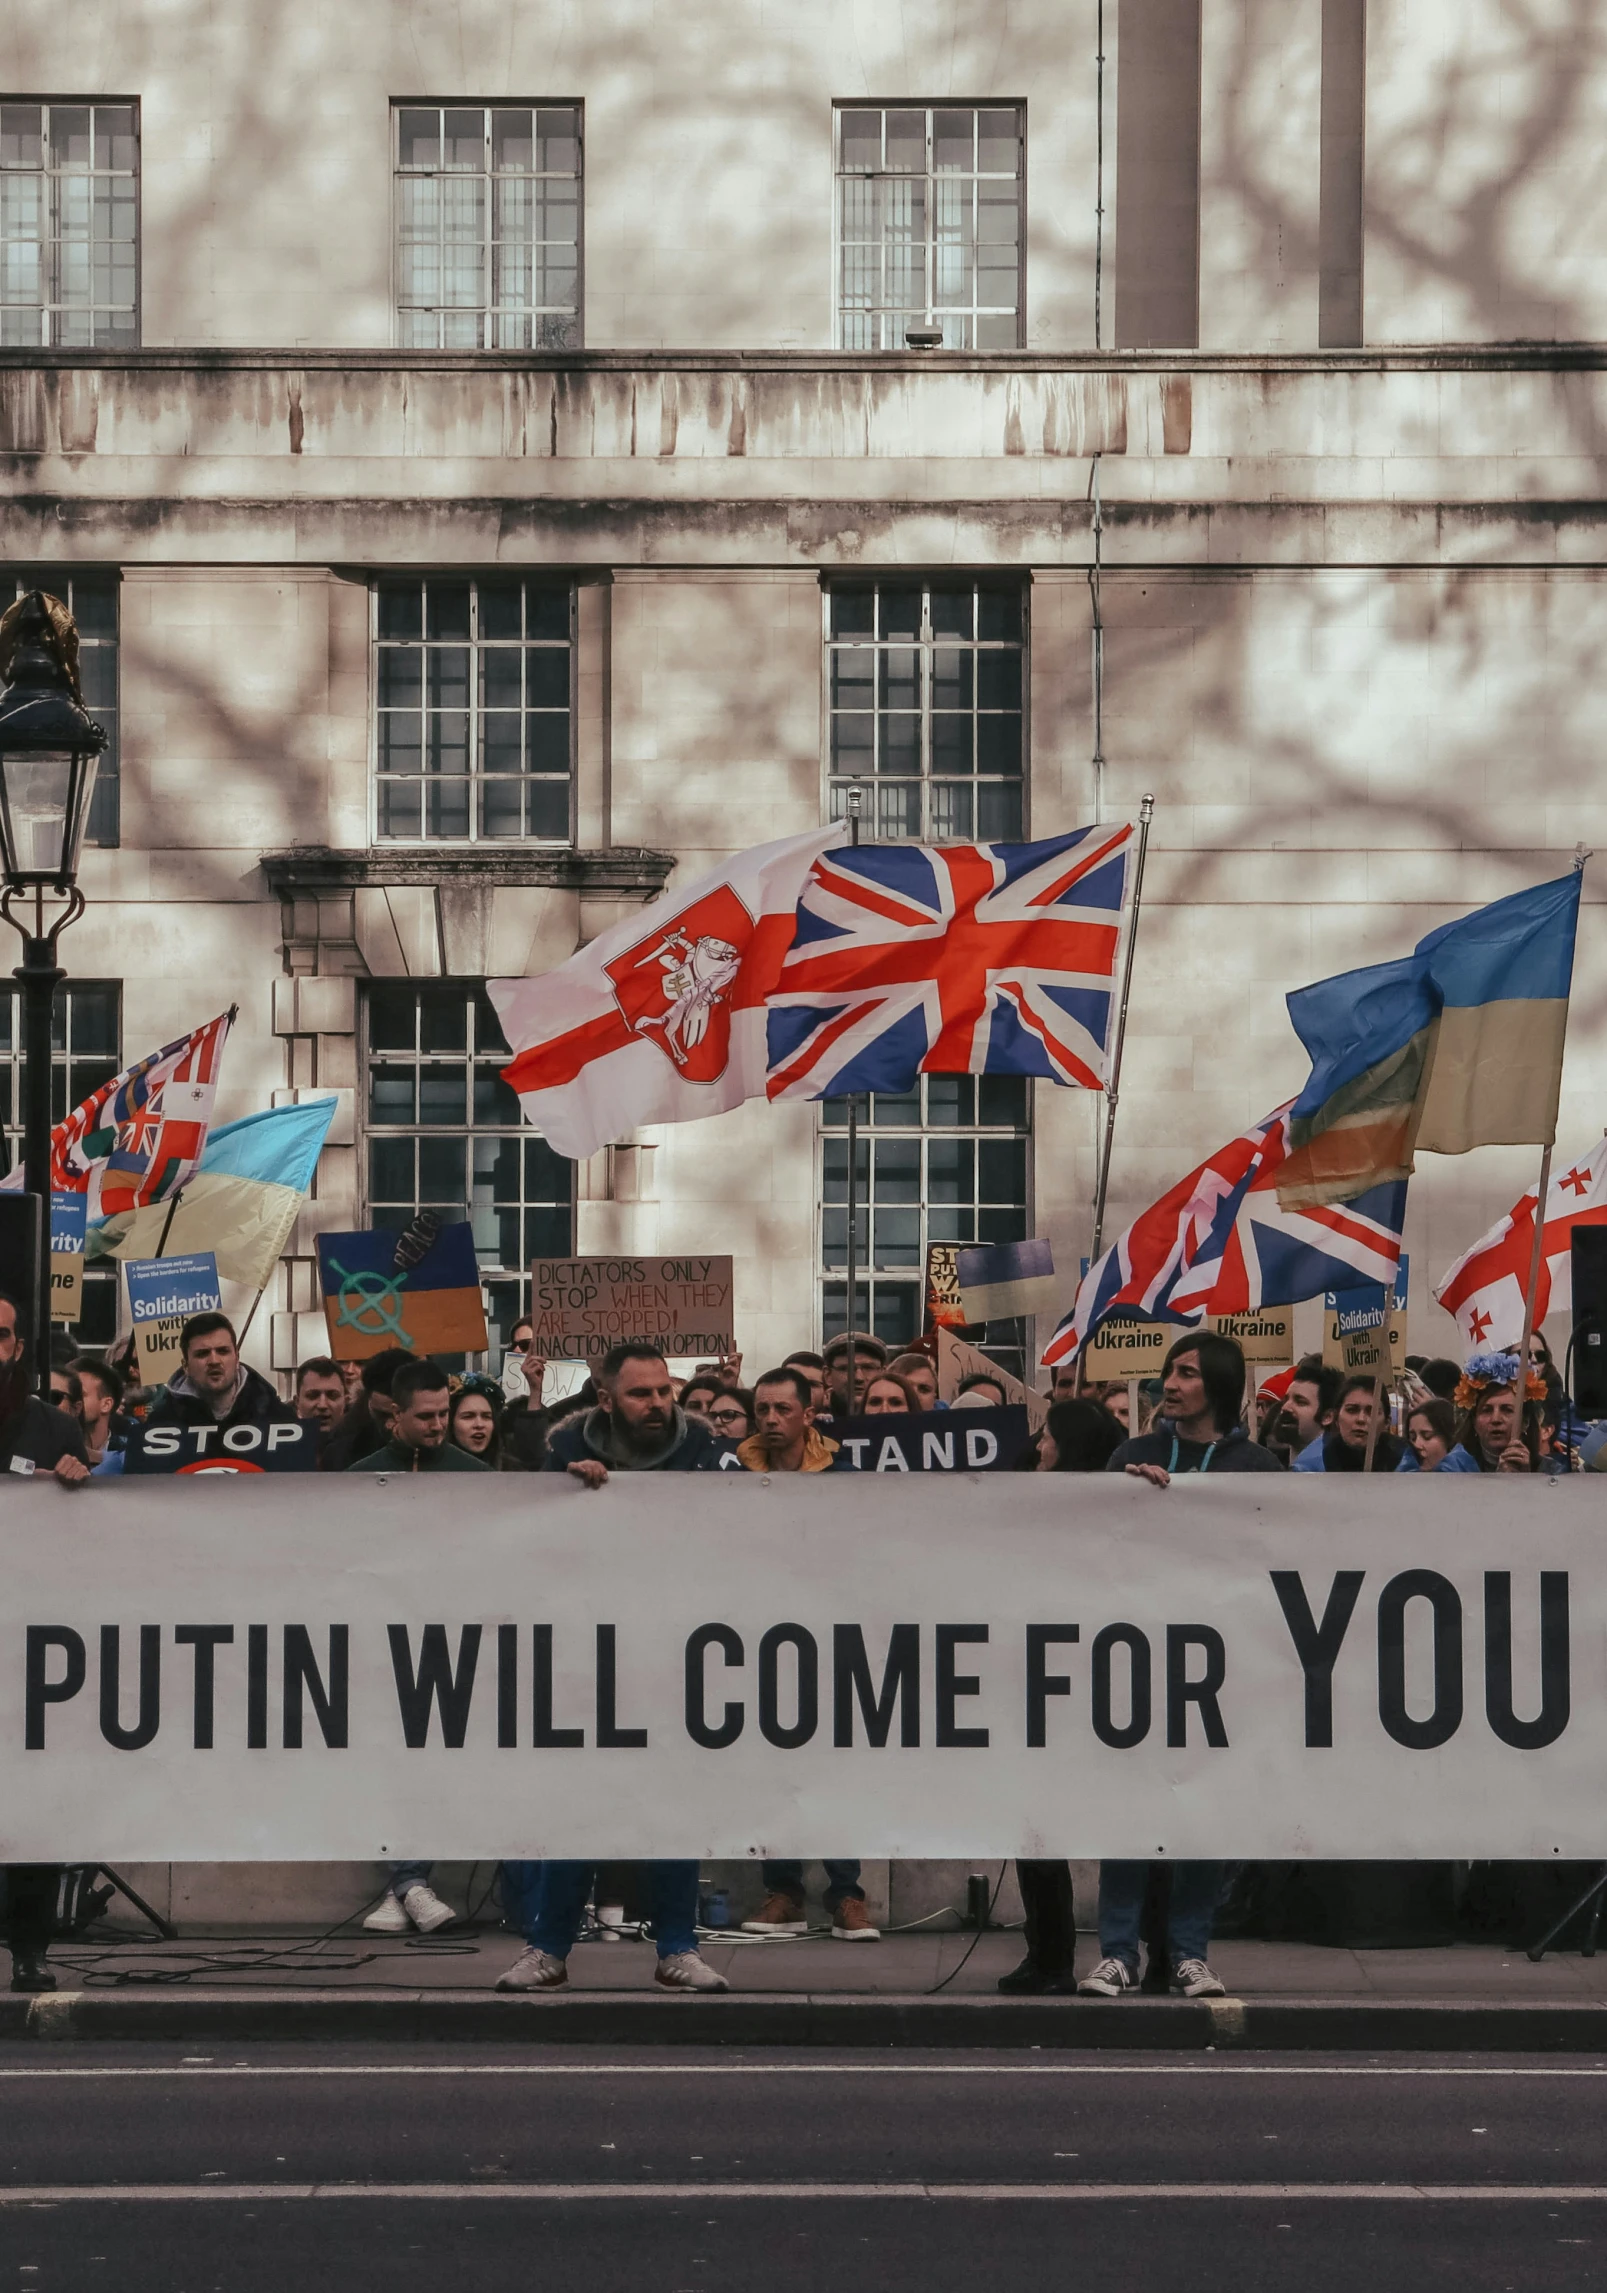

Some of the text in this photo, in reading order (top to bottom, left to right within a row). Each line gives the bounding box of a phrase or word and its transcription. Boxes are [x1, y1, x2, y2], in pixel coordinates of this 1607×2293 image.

[538, 1260, 711, 1285] DICTATORS ONLY
[134, 1292, 220, 1318] Solidarity
[538, 1284, 729, 1310] STOP WHEN THEY
[536, 1309, 679, 1335] ARE STOPPED!
[1217, 1318, 1286, 1337] Ukraine
[1340, 1307, 1385, 1330] Solidarity
[674, 1333, 730, 1354] OPTION
[1094, 1329, 1163, 1350] Ukraine
[1352, 1329, 1370, 1346] with
[1346, 1345, 1380, 1367] Ukrain
[142, 1423, 303, 1455] STOP
[842, 1428, 998, 1472] TAND
[25, 1569, 1570, 1751] PUTIN WILL COME FOR YOU
